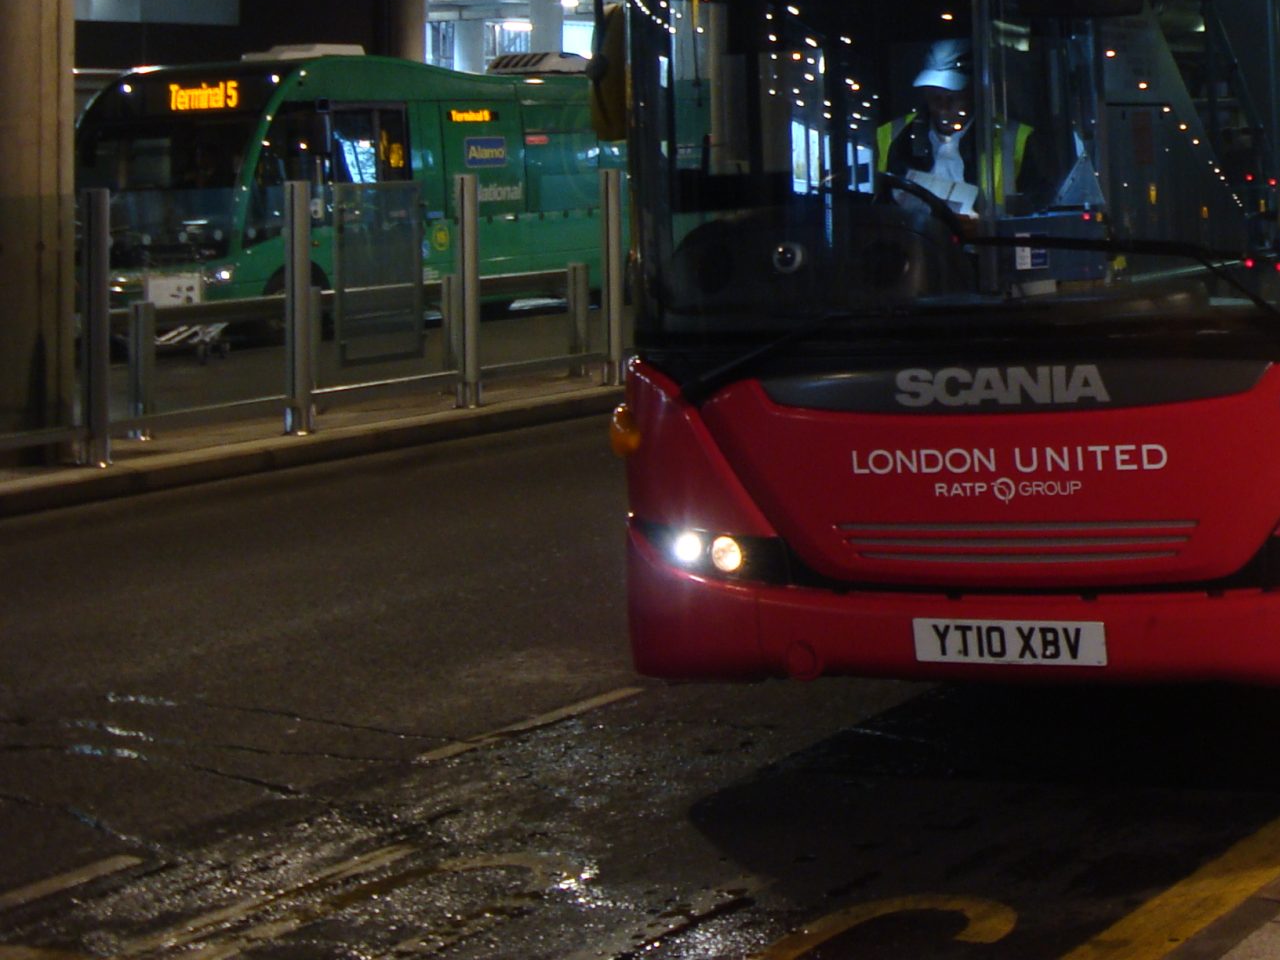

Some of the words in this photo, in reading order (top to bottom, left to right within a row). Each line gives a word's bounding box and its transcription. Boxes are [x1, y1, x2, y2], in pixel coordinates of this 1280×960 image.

[169, 81, 225, 111] Terminal
[226, 80, 238, 108] 5
[468, 145, 506, 160] Alamo
[894, 364, 1112, 408] SCANIA
[851, 448, 997, 475] LONDON
[1013, 443, 1169, 473] UNITED
[934, 482, 988, 497] RATP
[1017, 480, 1083, 497] GROUP
[931, 623, 1008, 660] YT10
[1016, 626, 1083, 661] XBV
